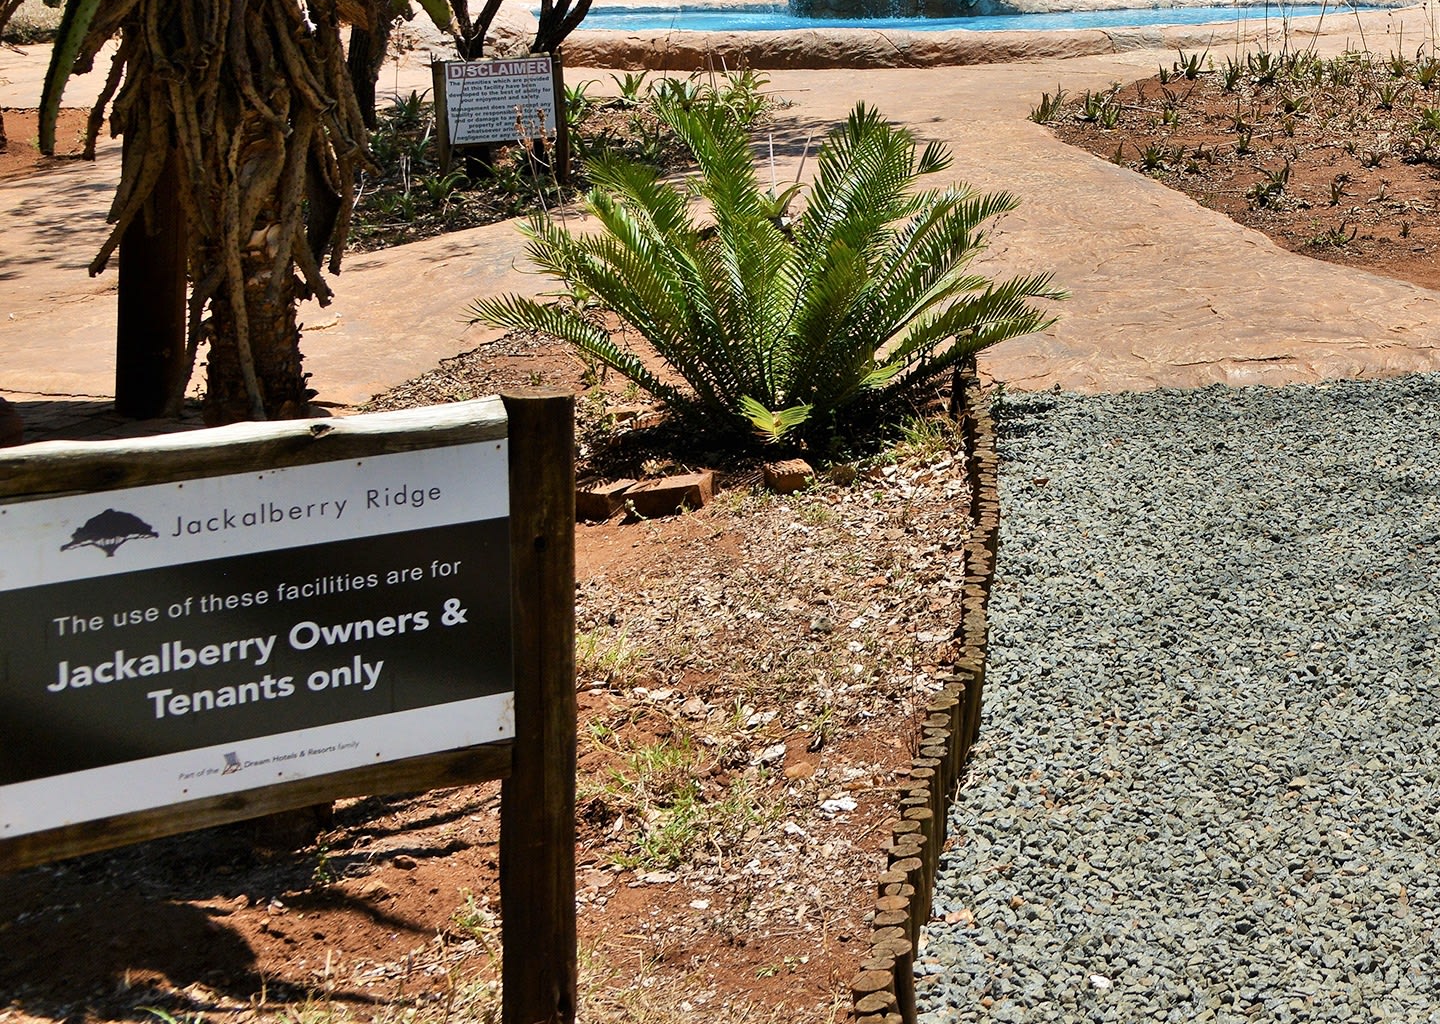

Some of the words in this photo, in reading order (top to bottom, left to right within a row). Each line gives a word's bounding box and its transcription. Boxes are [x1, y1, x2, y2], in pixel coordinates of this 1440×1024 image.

[451, 62, 548, 78] DISCLAIMER
[172, 500, 347, 537] Jackalberry
[367, 484, 441, 509] Ridge
[53, 615, 104, 636] The
[114, 607, 159, 628] use
[168, 597, 193, 618] of
[200, 587, 269, 613] these
[278, 573, 379, 601] facilities
[386, 567, 424, 585] are
[430, 560, 462, 578] for
[46, 634, 277, 692] Jackalberry
[288, 611, 430, 650] Owners
[441, 598, 468, 626] &
[147, 674, 296, 719] Tenants
[307, 655, 384, 691] only
[178, 772, 194, 780] Part
[244, 758, 270, 768] Dream
[272, 753, 297, 762] Hotels
[307, 746, 336, 756] Resorts
[337, 740, 360, 751] family
